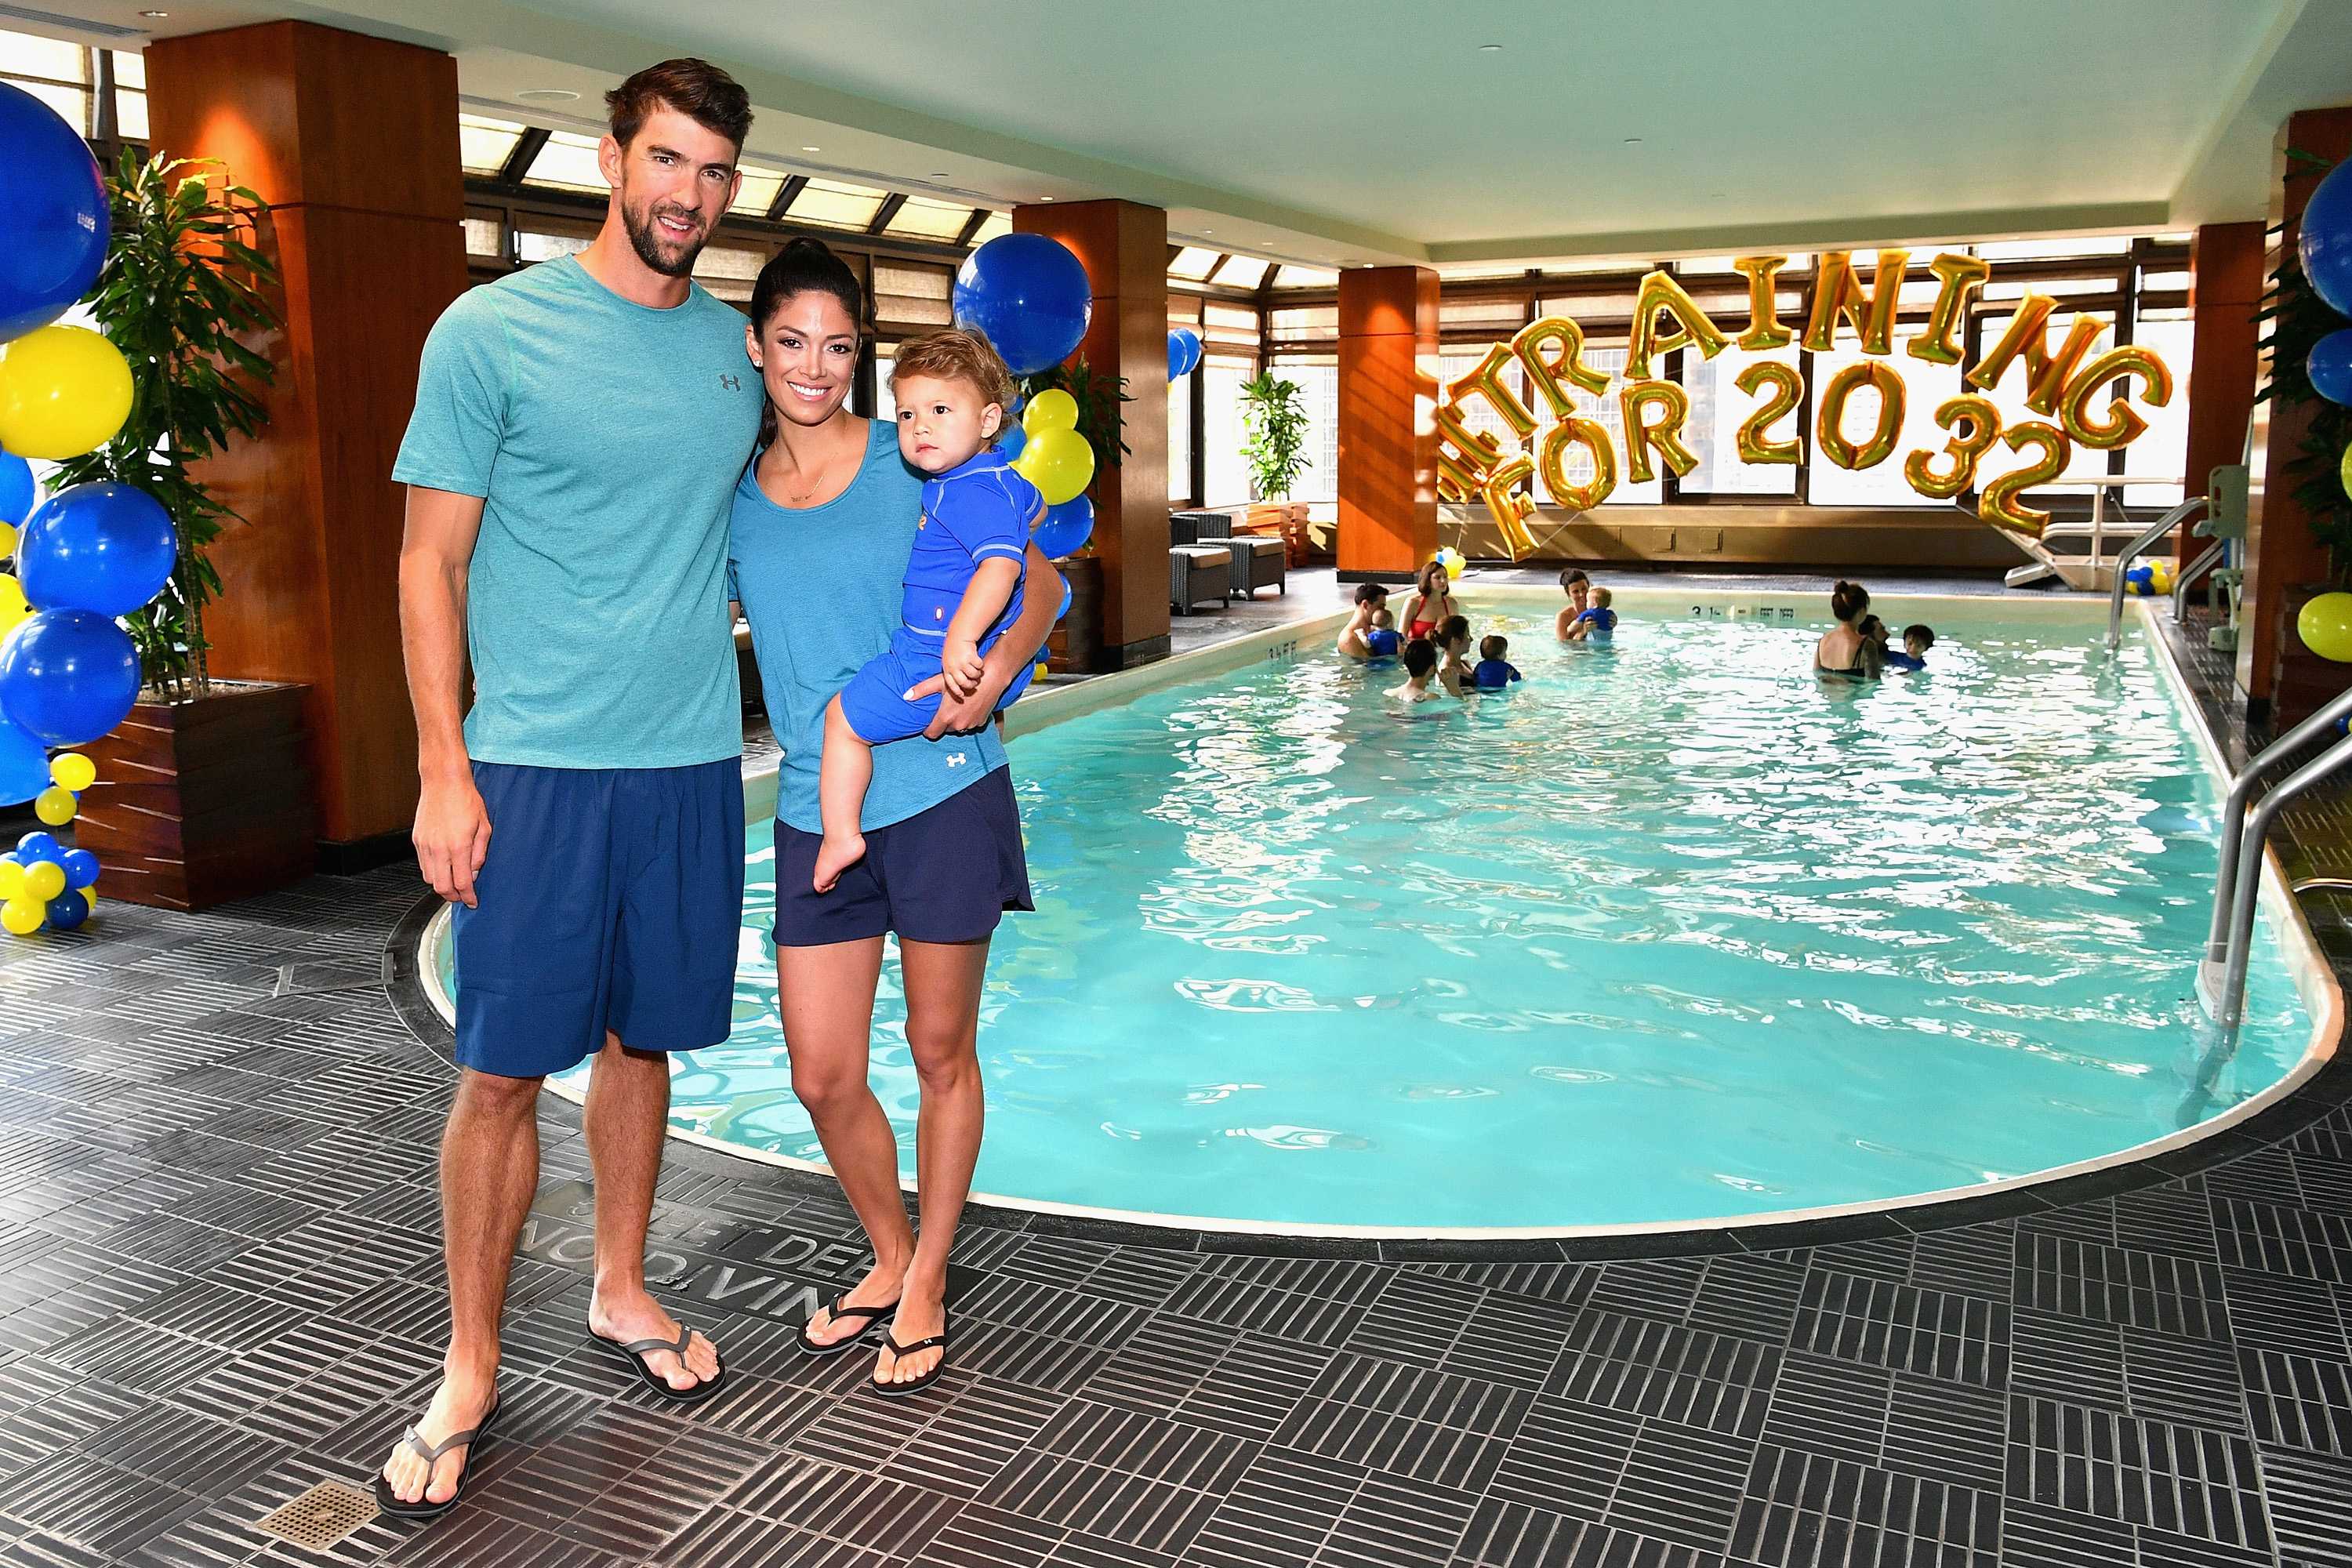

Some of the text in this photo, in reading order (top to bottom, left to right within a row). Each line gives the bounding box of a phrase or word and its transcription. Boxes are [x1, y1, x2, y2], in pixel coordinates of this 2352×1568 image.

[1446, 250, 2174, 448] TRAINING
[1481, 379, 1699, 563] FOR
[1734, 360, 2071, 536] 2032
[643, 1250, 819, 1320] DIVIN
[648, 1202, 774, 1253] EET
